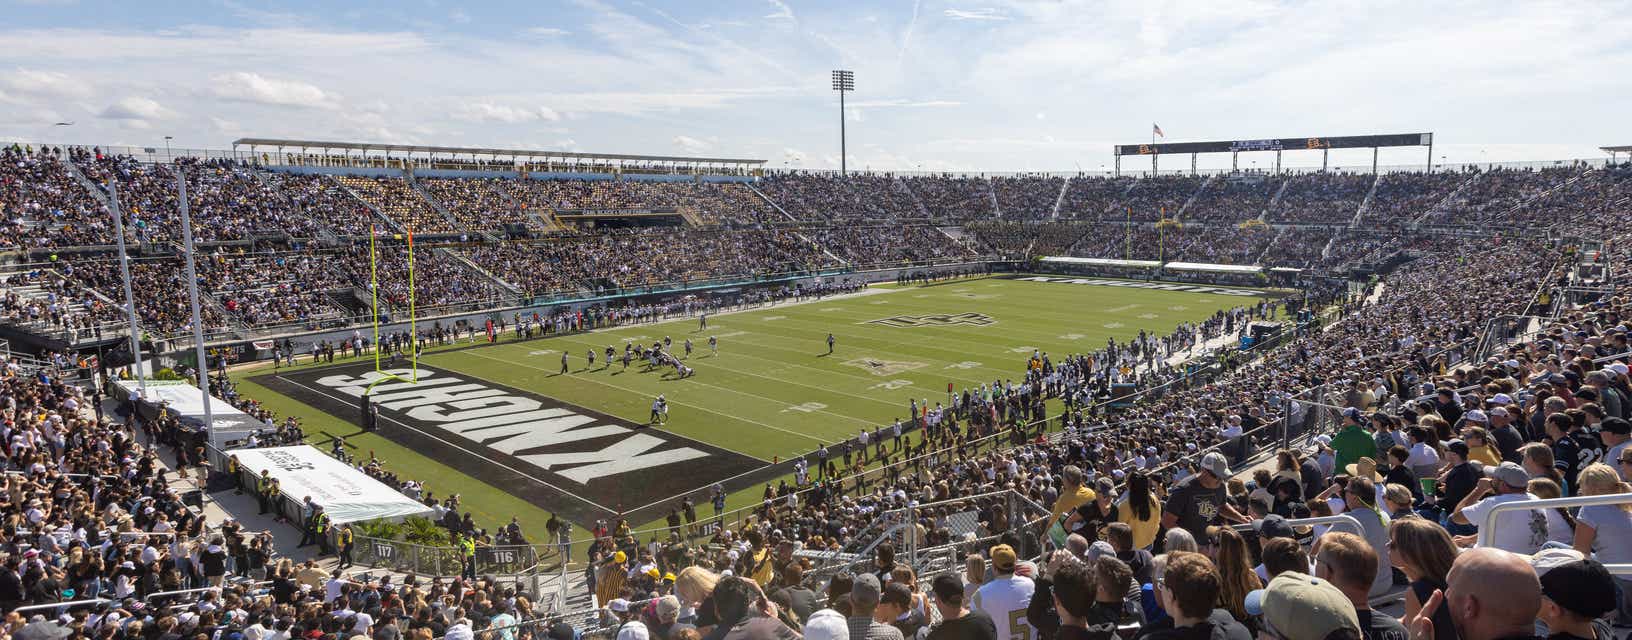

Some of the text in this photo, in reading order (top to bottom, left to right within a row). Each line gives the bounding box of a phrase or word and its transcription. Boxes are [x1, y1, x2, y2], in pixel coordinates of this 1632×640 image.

[315, 367, 712, 486] KNIGHTS
[377, 545, 392, 558] 117
[494, 551, 513, 563] 116
